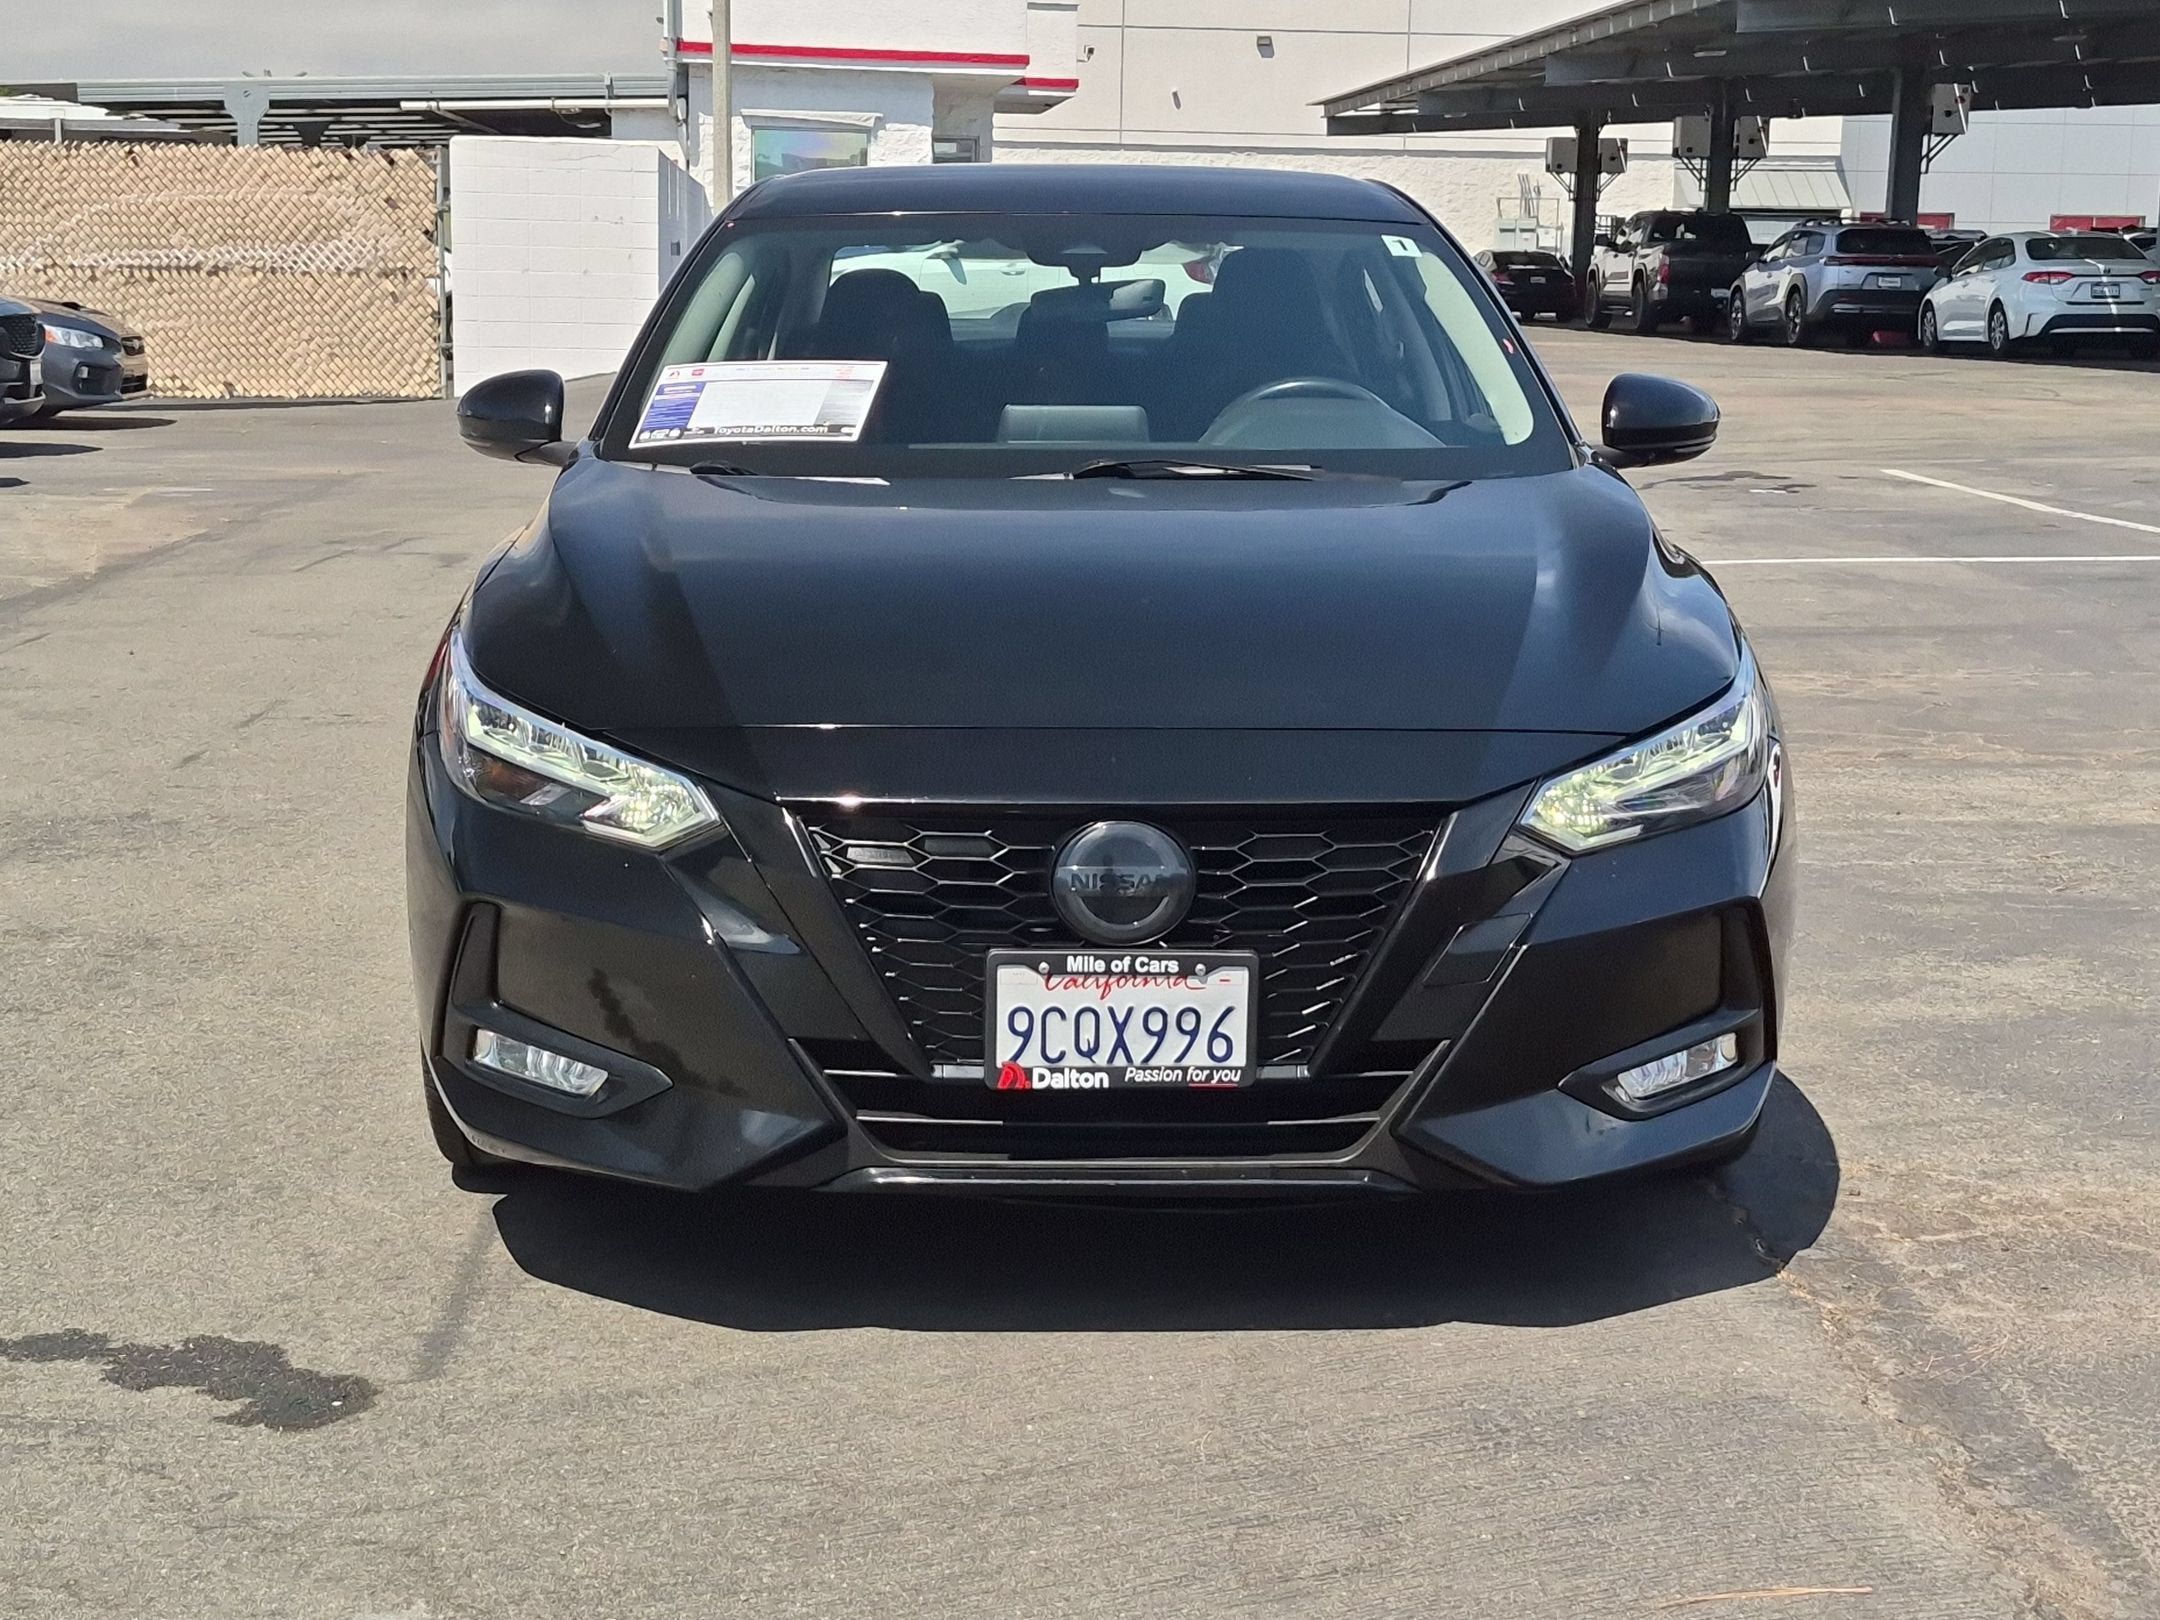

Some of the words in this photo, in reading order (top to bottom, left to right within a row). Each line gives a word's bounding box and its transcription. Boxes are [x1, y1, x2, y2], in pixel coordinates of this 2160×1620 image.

[713, 424, 829, 436] ToyotaDalton.com
[1070, 872, 1171, 891] NISSA
[1066, 955, 1106, 973] Mile
[1111, 955, 1132, 973] of
[1134, 956, 1180, 974] Cars
[1006, 1005, 1236, 1064] 9CQX996
[1031, 1067, 1110, 1090] Dalton
[1124, 1066, 1183, 1083] Passion
[1186, 1067, 1209, 1083] for
[1211, 1068, 1242, 1084] you
